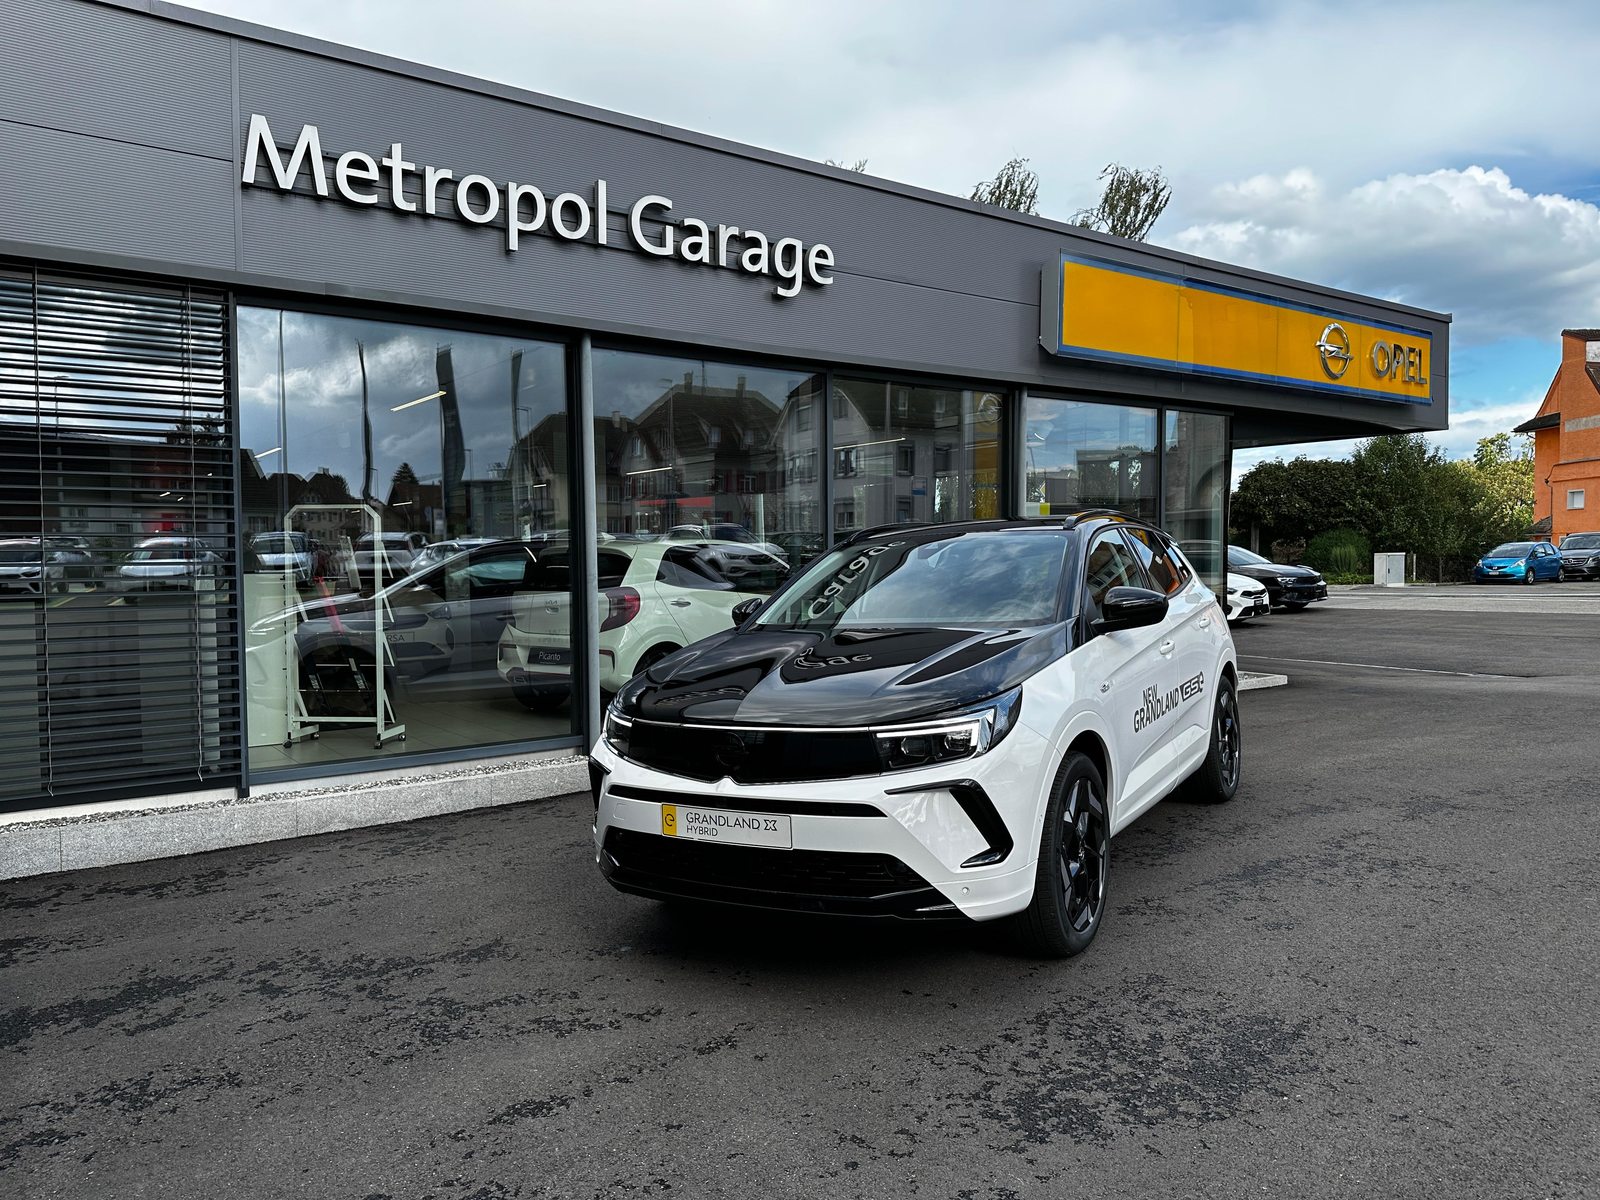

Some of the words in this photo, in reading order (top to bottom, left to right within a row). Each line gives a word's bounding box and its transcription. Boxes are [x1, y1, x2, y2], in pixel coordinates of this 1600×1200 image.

[241, 113, 608, 252] Metropol
[628, 194, 835, 298] Garage
[1371, 339, 1428, 385] OPEL
[538, 651, 561, 661] Picanto
[1142, 683, 1158, 707] NEW
[1133, 687, 1180, 734] GRANDLAND
[685, 811, 761, 831] GRANDLAND
[686, 825, 719, 837] HYBRID
